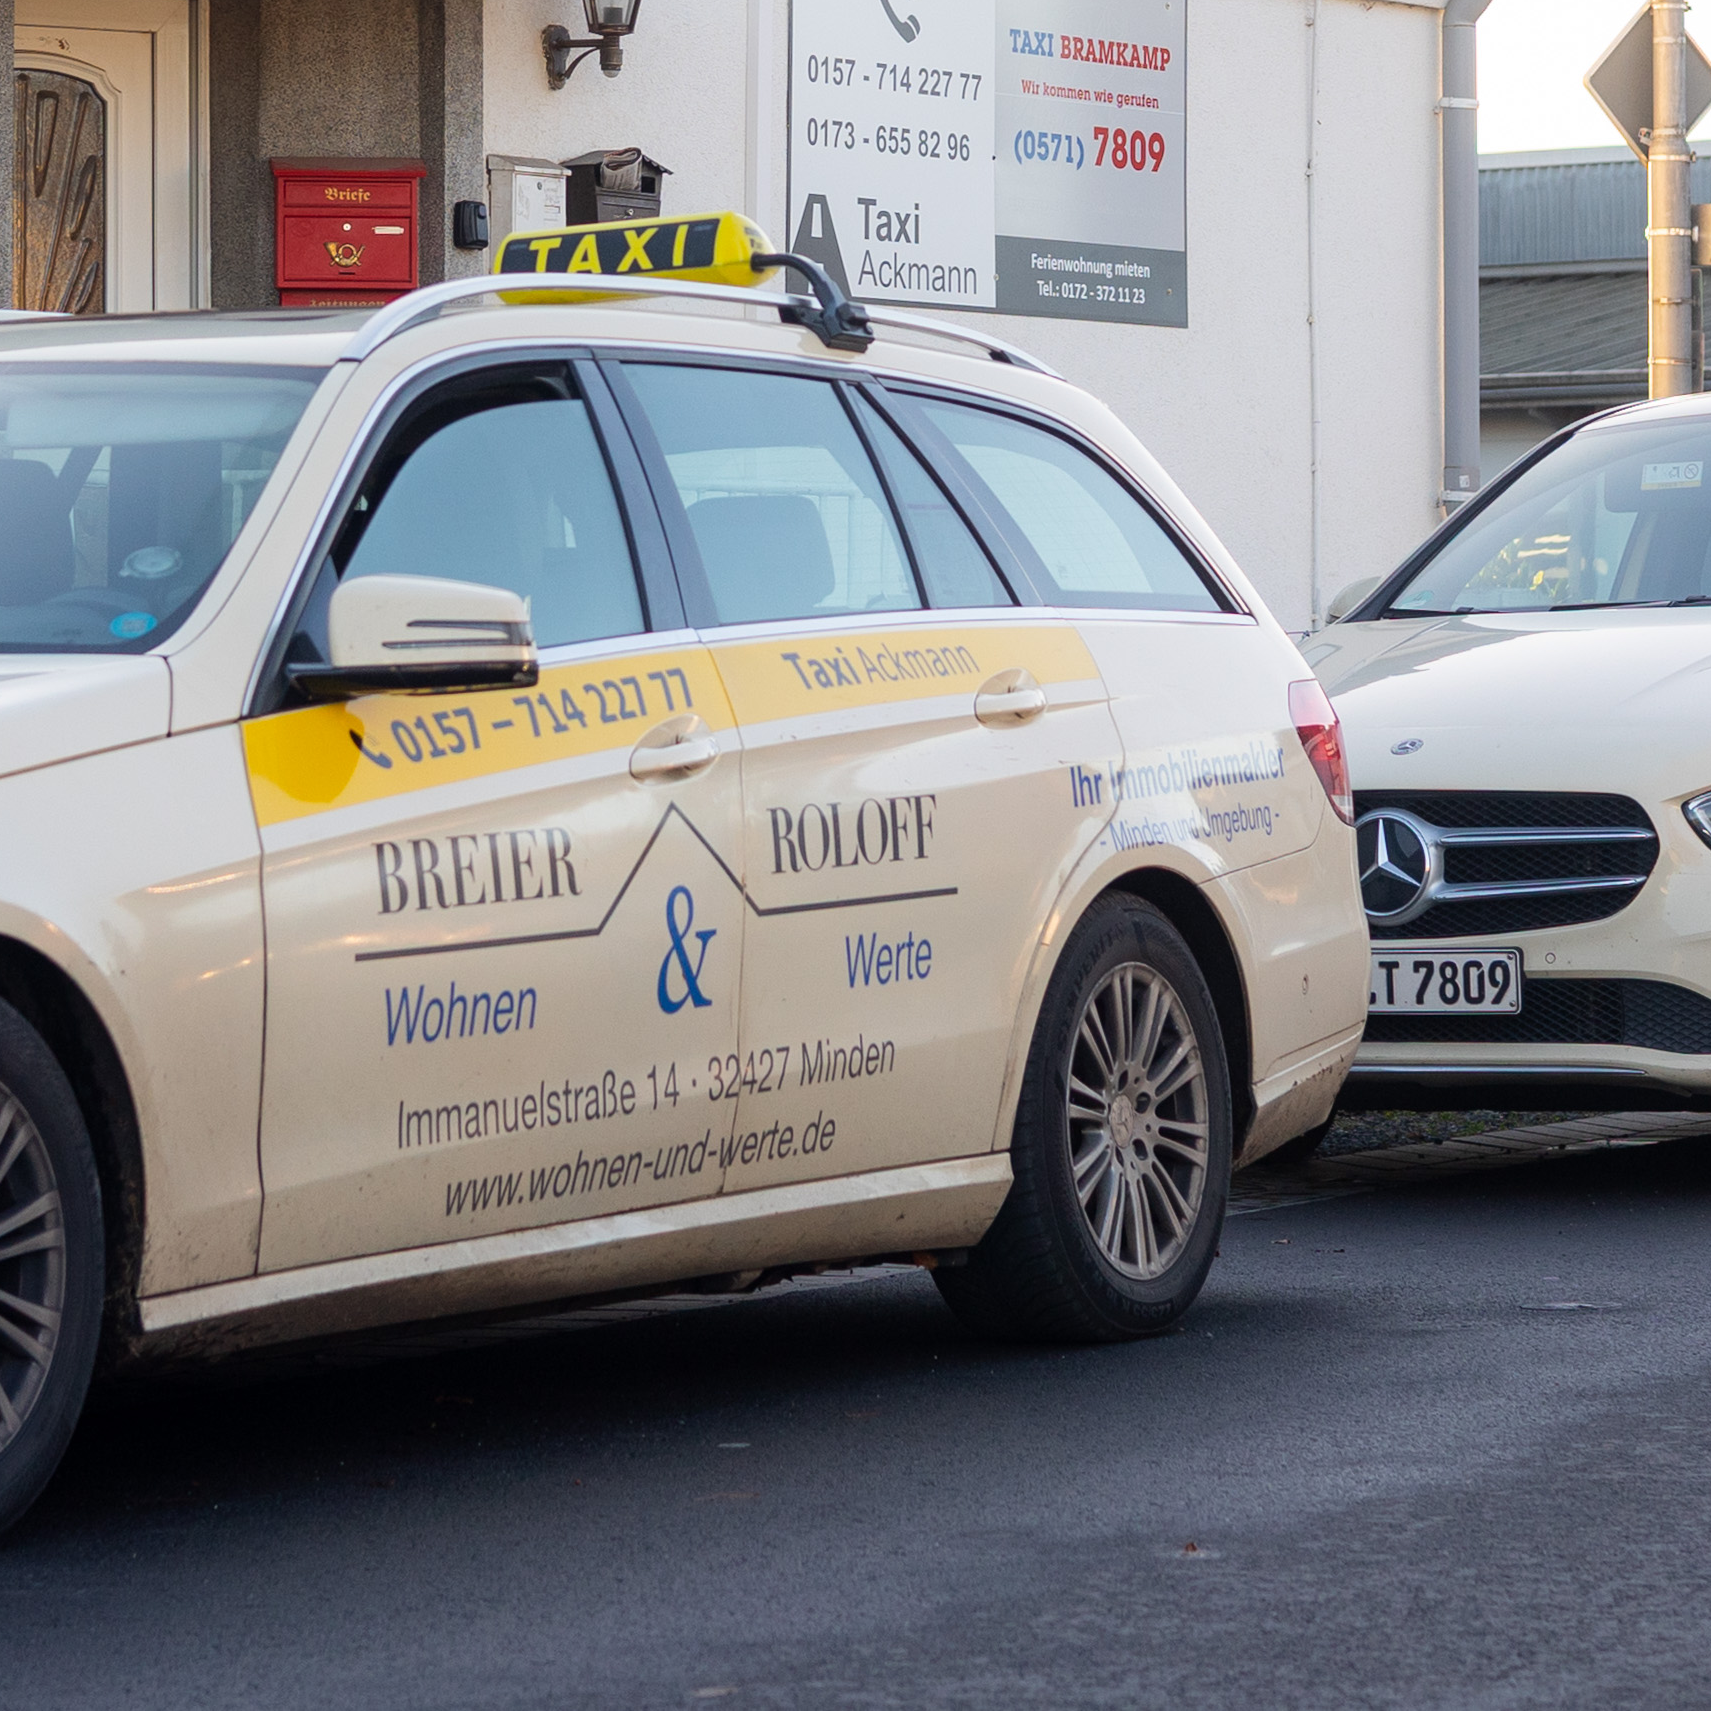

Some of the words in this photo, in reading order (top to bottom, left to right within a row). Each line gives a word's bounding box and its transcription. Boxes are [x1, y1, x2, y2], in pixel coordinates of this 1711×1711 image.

[1009, 28, 1054, 58] TAXI
[1060, 34, 1171, 72] BRAMKAMP
[807, 54, 856, 87] 0157
[876, 62, 911, 94] 714
[918, 67, 953, 98] 227
[959, 72, 982, 101] 77
[1021, 79, 1040, 95] Wir
[1042, 81, 1091, 102] kommen
[1094, 88, 1114, 104] wie
[1116, 92, 1159, 109] gerufen
[807, 117, 856, 150] 0173
[876, 125, 911, 156] 655
[918, 129, 941, 159] 82
[947, 132, 971, 162] 96
[1014, 129, 1085, 171] (0571)
[1093, 126, 1165, 173] 7809
[324, 187, 371, 204] Briefe
[857, 197, 920, 245] Taxi
[529, 223, 690, 274] TAXI
[857, 249, 977, 295] Ackmann
[1031, 253, 1113, 279] Ferienwohnung
[1114, 260, 1151, 278] mieten
[1036, 280, 1060, 297] Tel.:
[1061, 282, 1088, 300] 0172
[1096, 285, 1116, 302] 372
[1117, 287, 1131, 303] 11
[1132, 288, 1146, 304] 23
[781, 647, 862, 690] Taxi
[855, 643, 981, 683] Ackmann
[391, 707, 481, 763] 0157
[512, 688, 588, 737] 714
[583, 676, 648, 724] 227
[647, 668, 694, 711] 77
[1069, 764, 1102, 808] Ihr
[1107, 740, 1286, 803] Immobilienmakler
[1109, 816, 1171, 852] Minden
[1171, 809, 1200, 843] und
[1202, 802, 1273, 842] Umgebung
[371, 826, 583, 916] BREIER
[767, 794, 938, 875] ROLOFF
[657, 885, 718, 1014] &
[384, 981, 538, 1047] Wohnen
[844, 931, 933, 989] Werte
[1369, 959, 1400, 1006] T
[1413, 959, 1512, 1006] 7809
[397, 1069, 637, 1150] Immanuelstraße
[646, 1062, 682, 1111] 14
[707, 1046, 791, 1102] 32427
[800, 1033, 896, 1087] Minden
[444, 1109, 838, 1217] www.wohnen-und-werte.de
